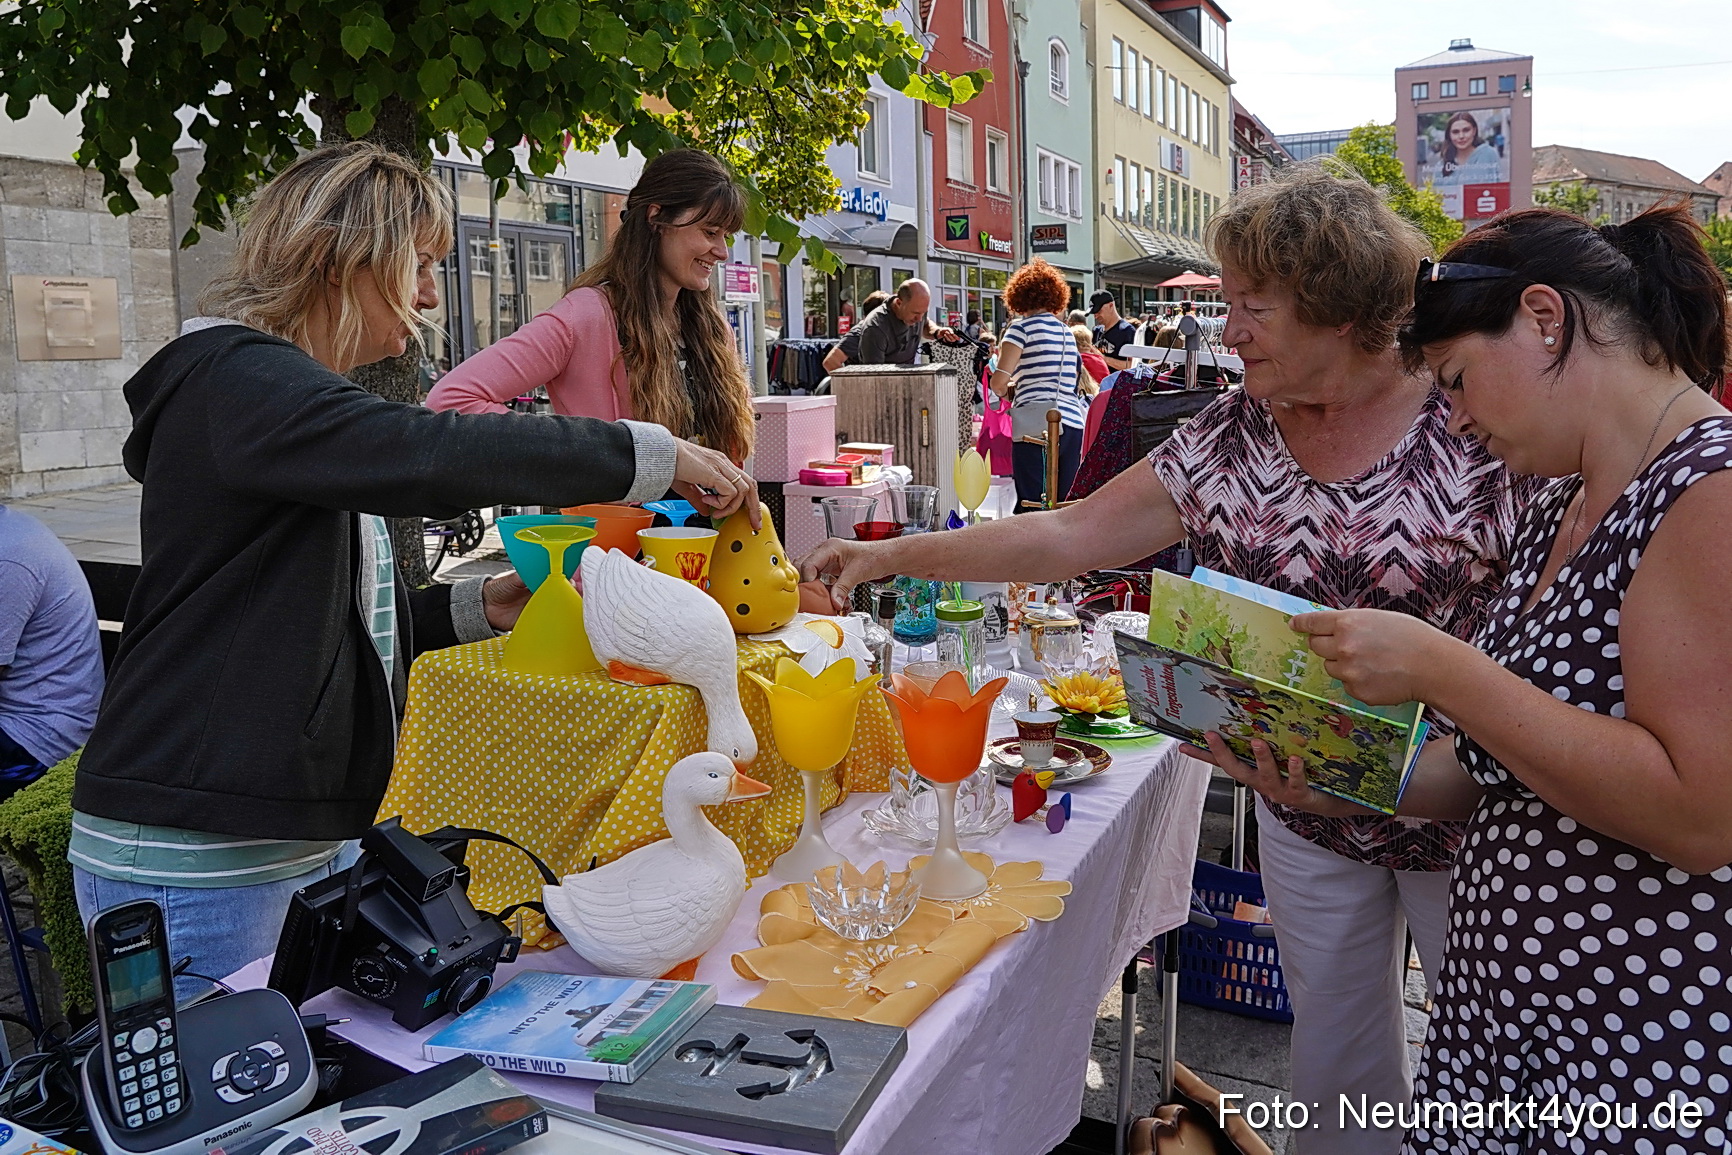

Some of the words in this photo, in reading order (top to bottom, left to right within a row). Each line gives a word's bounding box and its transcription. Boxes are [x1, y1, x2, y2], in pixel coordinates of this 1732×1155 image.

[1034, 227, 1065, 239] SIPL
[988, 235, 1012, 253] freenet
[1139, 665, 1160, 707] Lehrreiche
[113, 939, 151, 954] Panasonic
[508, 1016, 538, 1035] INTO
[534, 1001, 560, 1015] THE
[554, 980, 583, 1000] WILD
[610, 1042, 629, 1052] 12
[500, 1056, 527, 1071] THE
[530, 1059, 567, 1074] WILD
[204, 1121, 253, 1147] Panasonic
